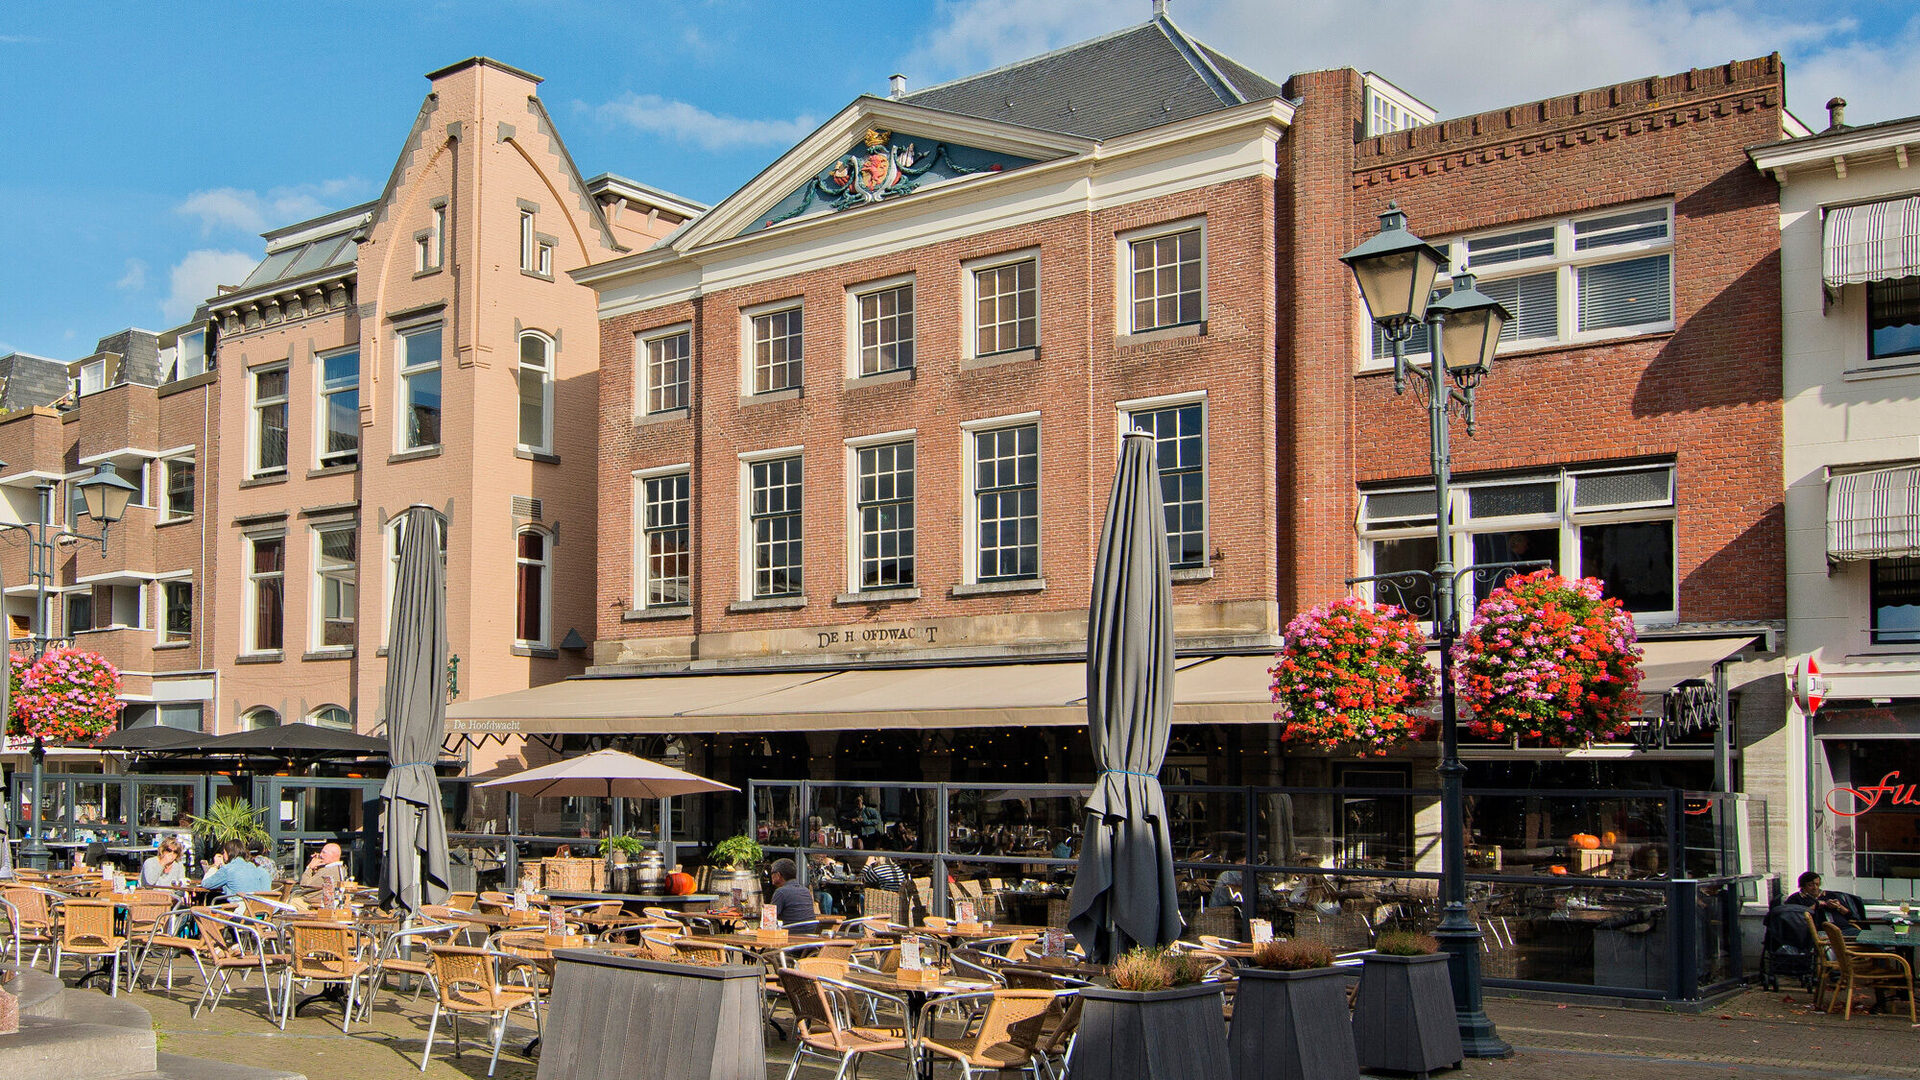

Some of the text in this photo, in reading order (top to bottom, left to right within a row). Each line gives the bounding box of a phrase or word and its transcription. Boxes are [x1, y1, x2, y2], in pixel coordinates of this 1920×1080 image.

[818, 632, 839, 648] DE
[454, 719, 520, 731] De Hoofdwacht
